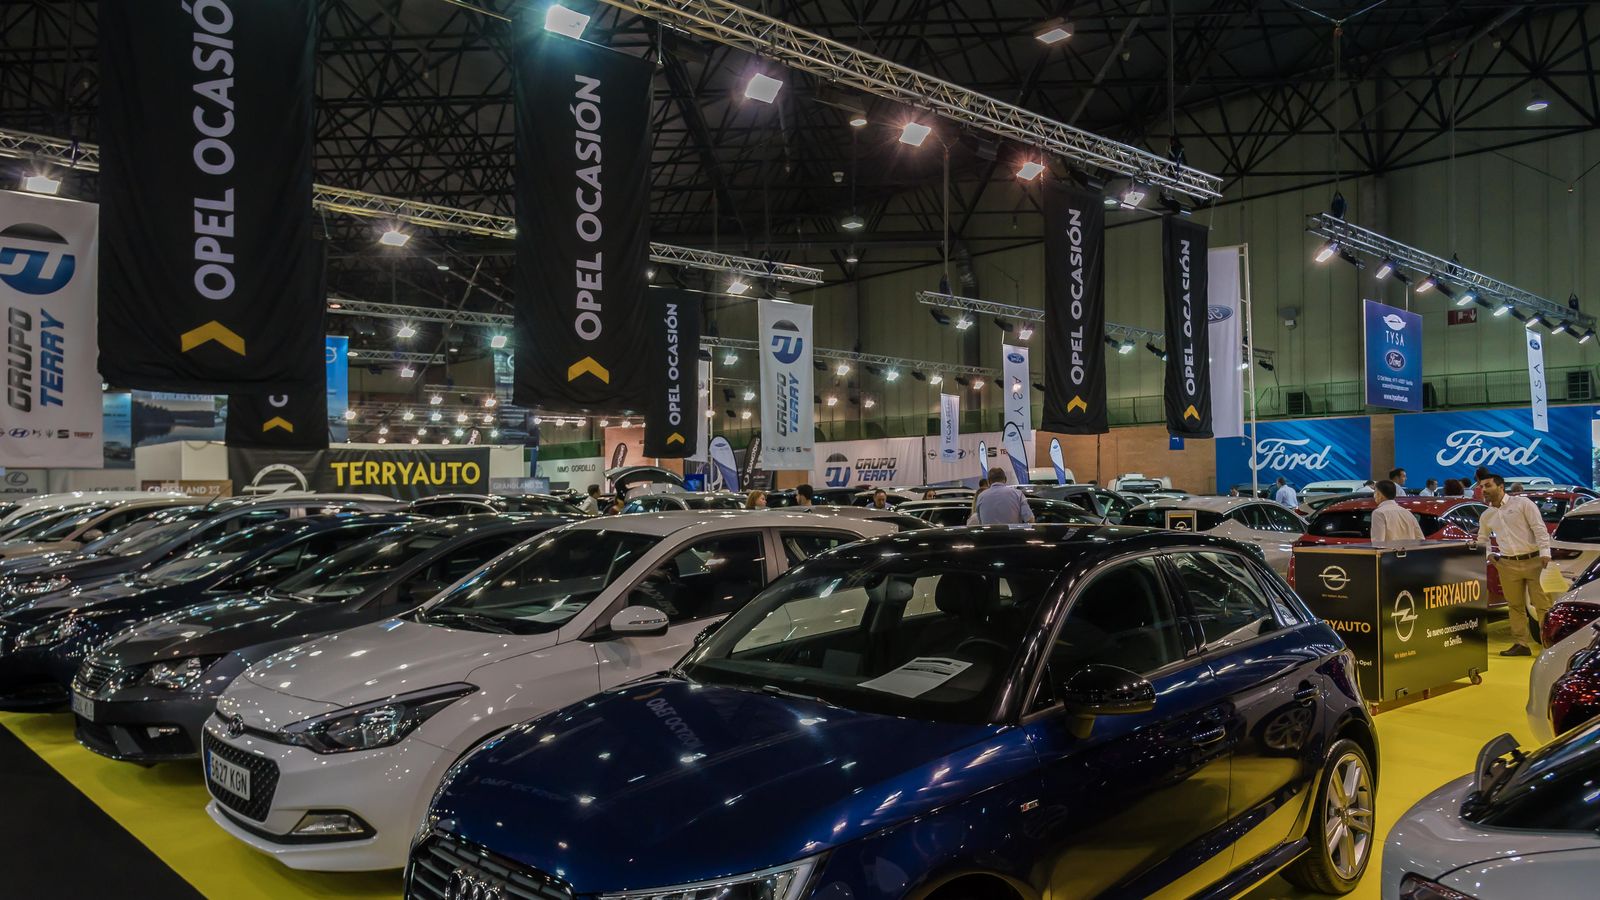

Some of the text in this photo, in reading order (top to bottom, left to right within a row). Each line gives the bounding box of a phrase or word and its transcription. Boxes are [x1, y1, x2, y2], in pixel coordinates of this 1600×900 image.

[569, 74, 603, 341] OPEL OCASIÓN
[194, 188, 236, 300] OPEL
[1068, 208, 1085, 386] OPEL OCASIÓN
[1179, 239, 1196, 396] OPEL OCASIÓN
[40, 307, 65, 408] TERRY
[1385, 330, 1405, 347] TYSA
[7, 306, 32, 413] GRUPO
[664, 302, 682, 427] OPEL OCASIÓN
[776, 371, 788, 437] GRUPO
[788, 370, 800, 433] TERRY
[855, 457, 898, 470] GRUPO
[1249, 437, 1331, 472] Ford
[1435, 429, 1544, 468] Ford
[330, 461, 481, 487] TERRYAUTO
[856, 469, 898, 481] TERRY
[1423, 580, 1480, 609] TERRYAUTO
[1469, 617, 1479, 630] Opel
[1359, 659, 1372, 667] Opel
[211, 757, 247, 795] 5627 KGN
